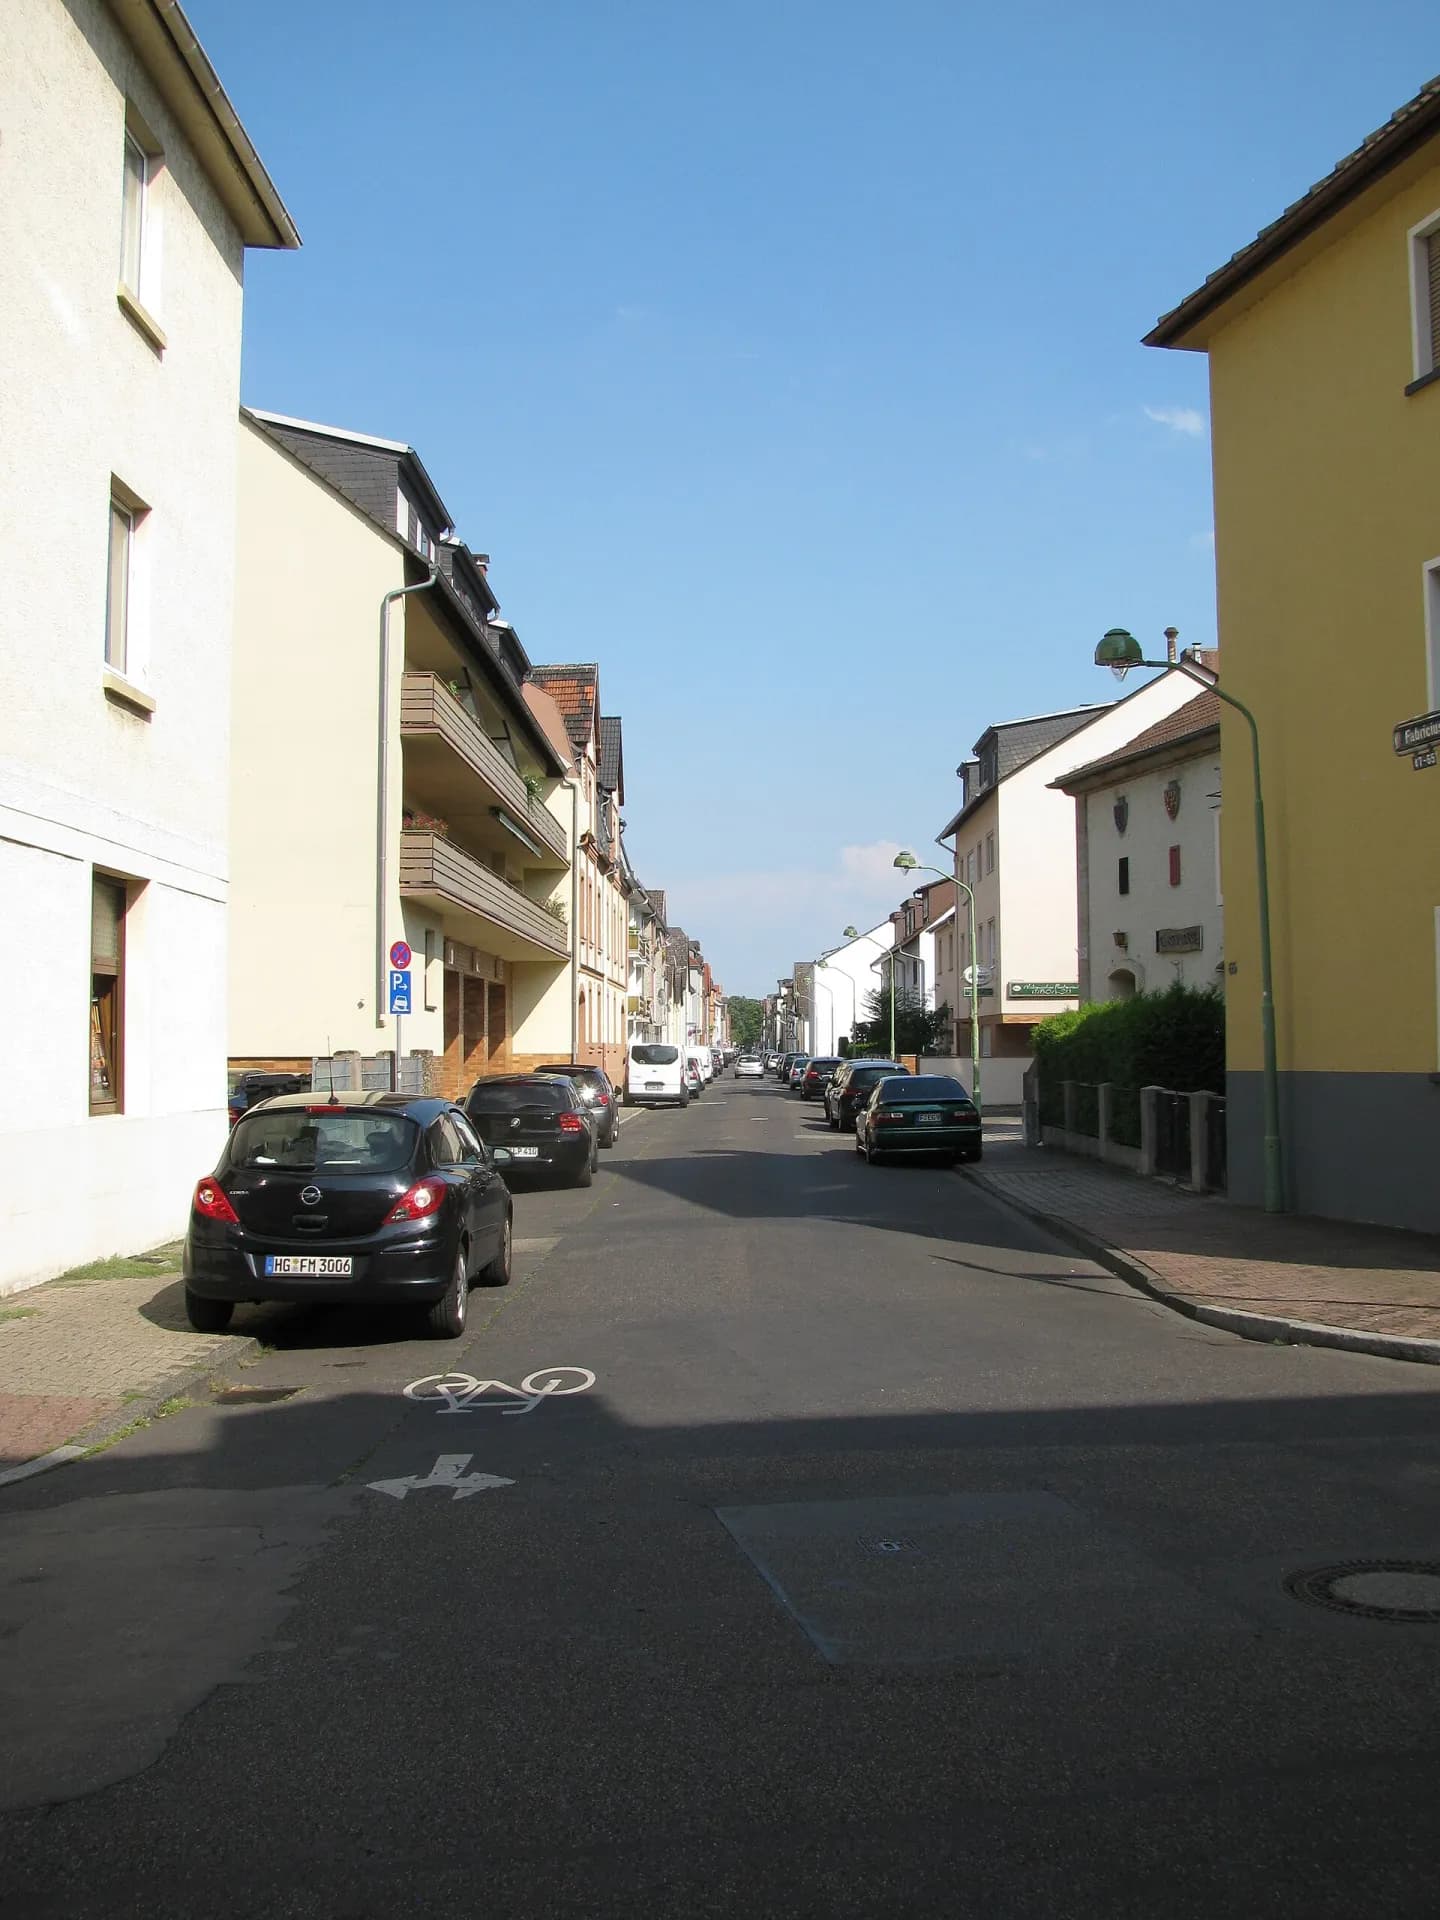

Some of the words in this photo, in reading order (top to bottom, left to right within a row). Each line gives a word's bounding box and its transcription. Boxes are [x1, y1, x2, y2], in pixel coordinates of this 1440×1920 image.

[393, 973, 403, 991] P
[274, 1258, 291, 1272] HG
[299, 1258, 316, 1273] FM
[319, 1258, 351, 1273] 3006
